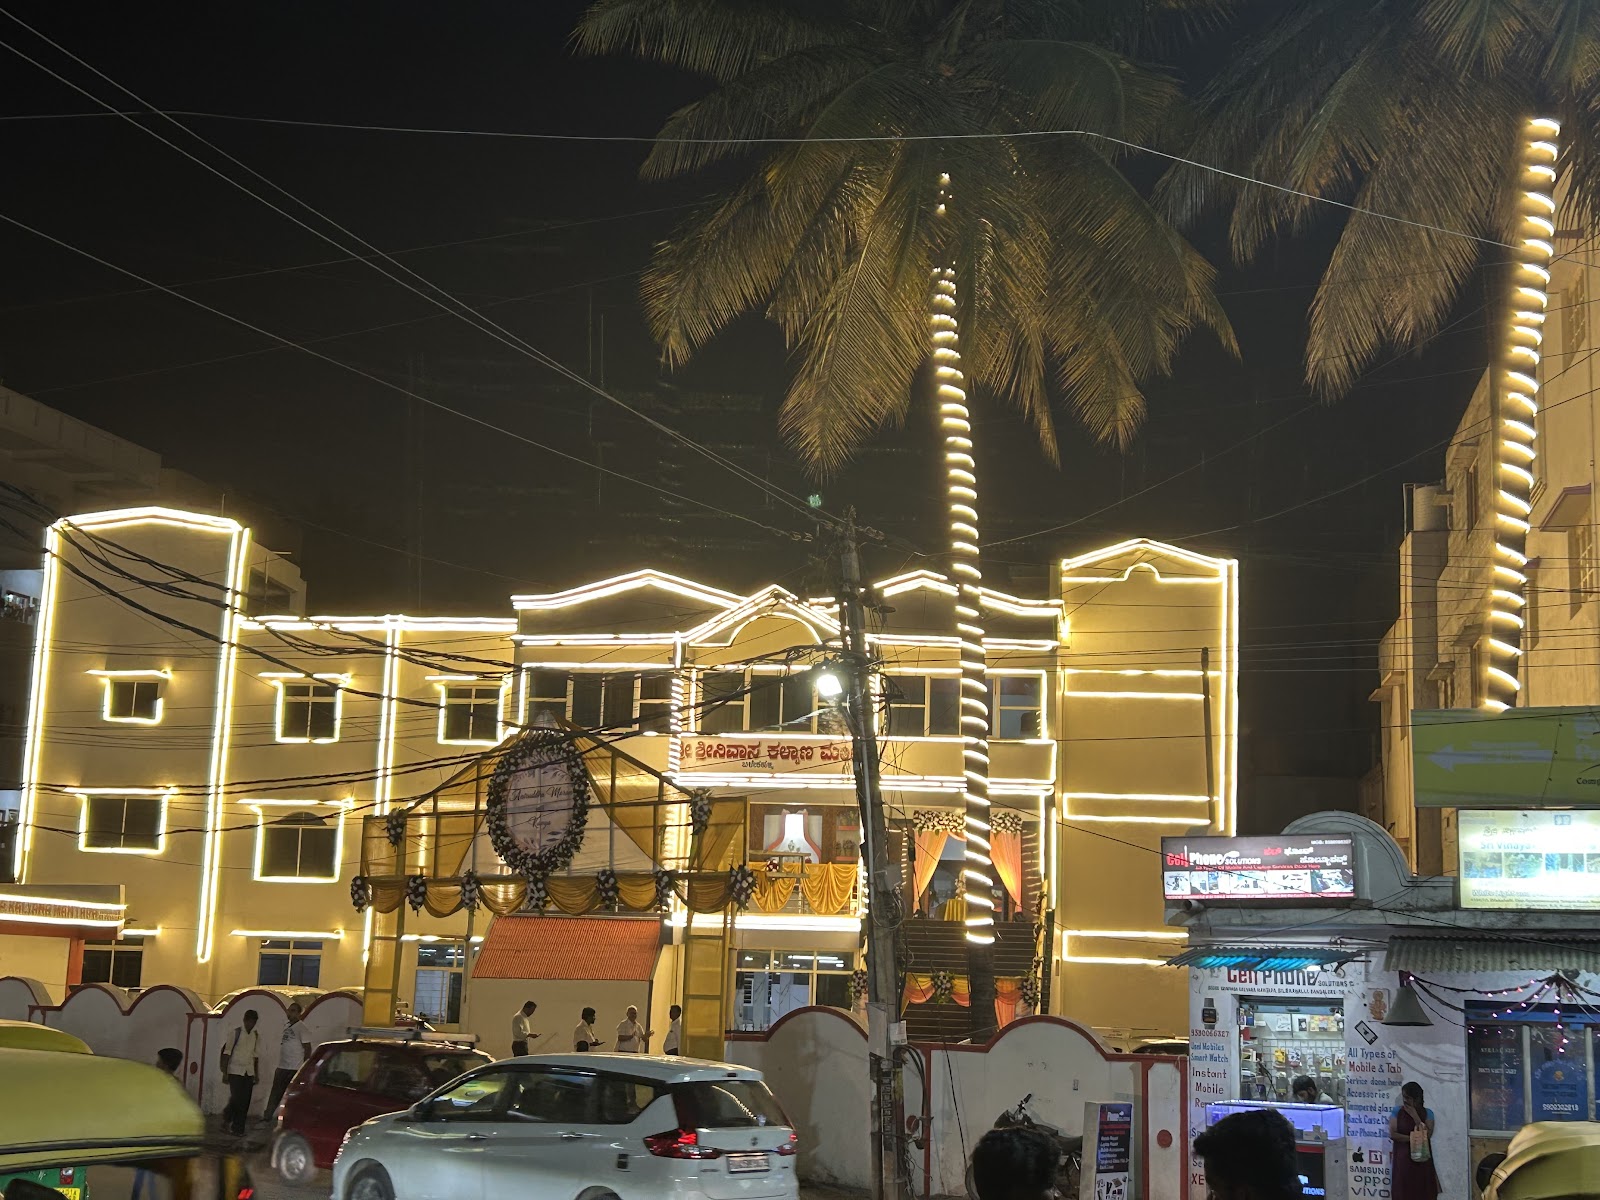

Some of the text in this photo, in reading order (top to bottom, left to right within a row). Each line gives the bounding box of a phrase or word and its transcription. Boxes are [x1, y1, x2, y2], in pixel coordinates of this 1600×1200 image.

[696, 741, 761, 760] ಶ್ರೀನಿವಾಸ
[1348, 1047, 1357, 1058] All
[1360, 1048, 1386, 1060] Types
[1192, 1066, 1227, 1079] Instant
[1349, 1061, 1402, 1074] Mobile & Tab
[1196, 1082, 1224, 1095] Mobile
[1347, 1088, 1390, 1099] Accessories
[1378, 1103, 1392, 1114] glas
[1350, 1166, 1390, 1175] SAMSUNG
